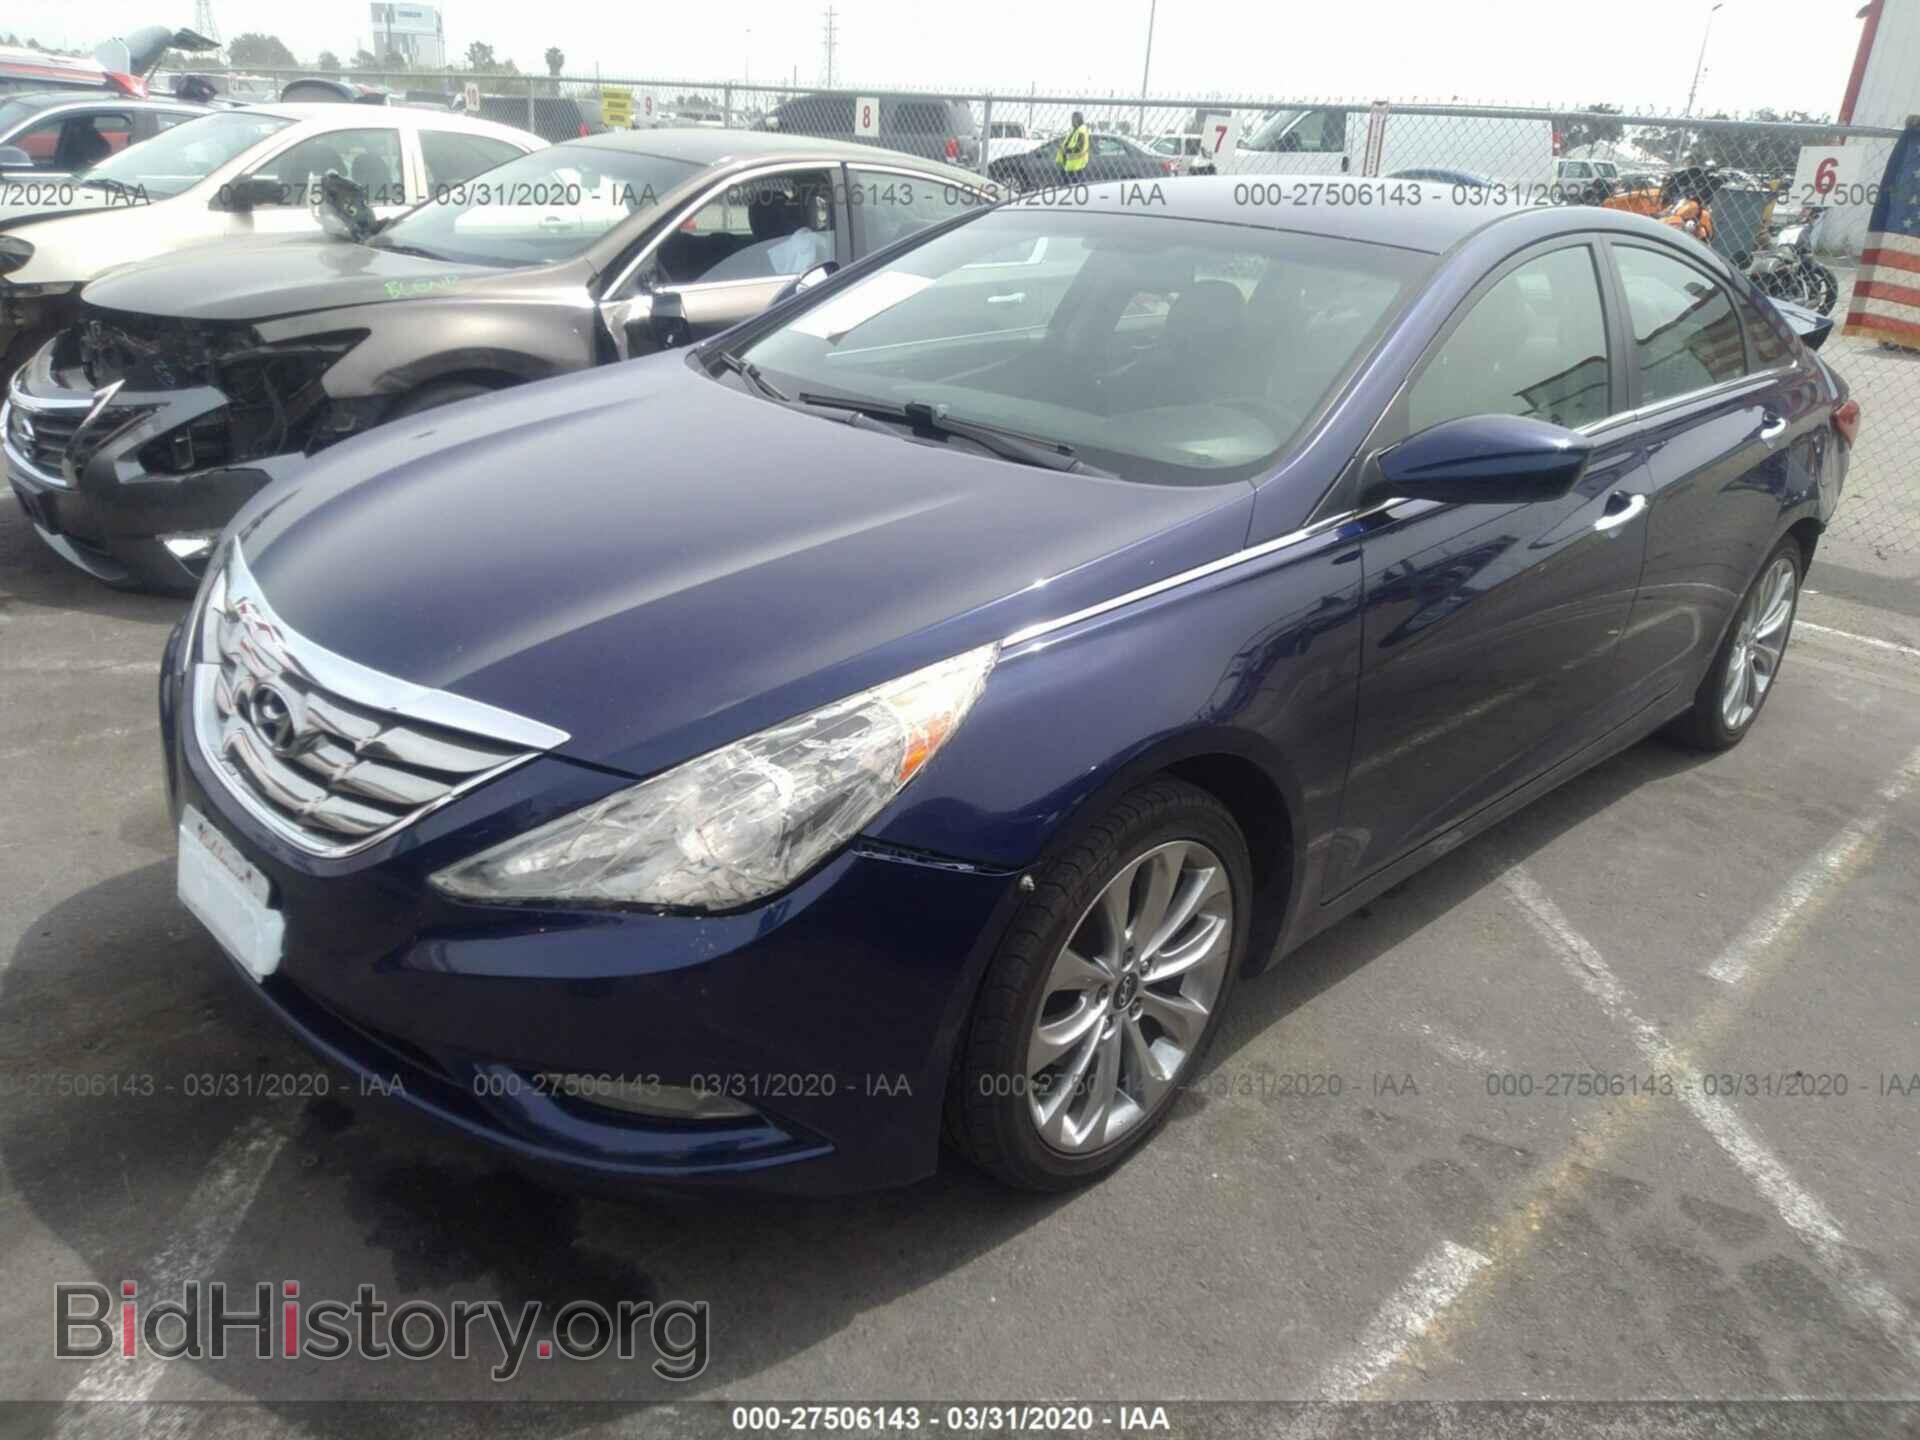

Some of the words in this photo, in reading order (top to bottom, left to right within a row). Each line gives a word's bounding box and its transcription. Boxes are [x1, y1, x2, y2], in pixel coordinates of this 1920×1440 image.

[645, 96, 652, 115] 9
[863, 105, 871, 128] 8
[1214, 126, 1228, 152] 7
[1815, 157, 1838, 194] 6
